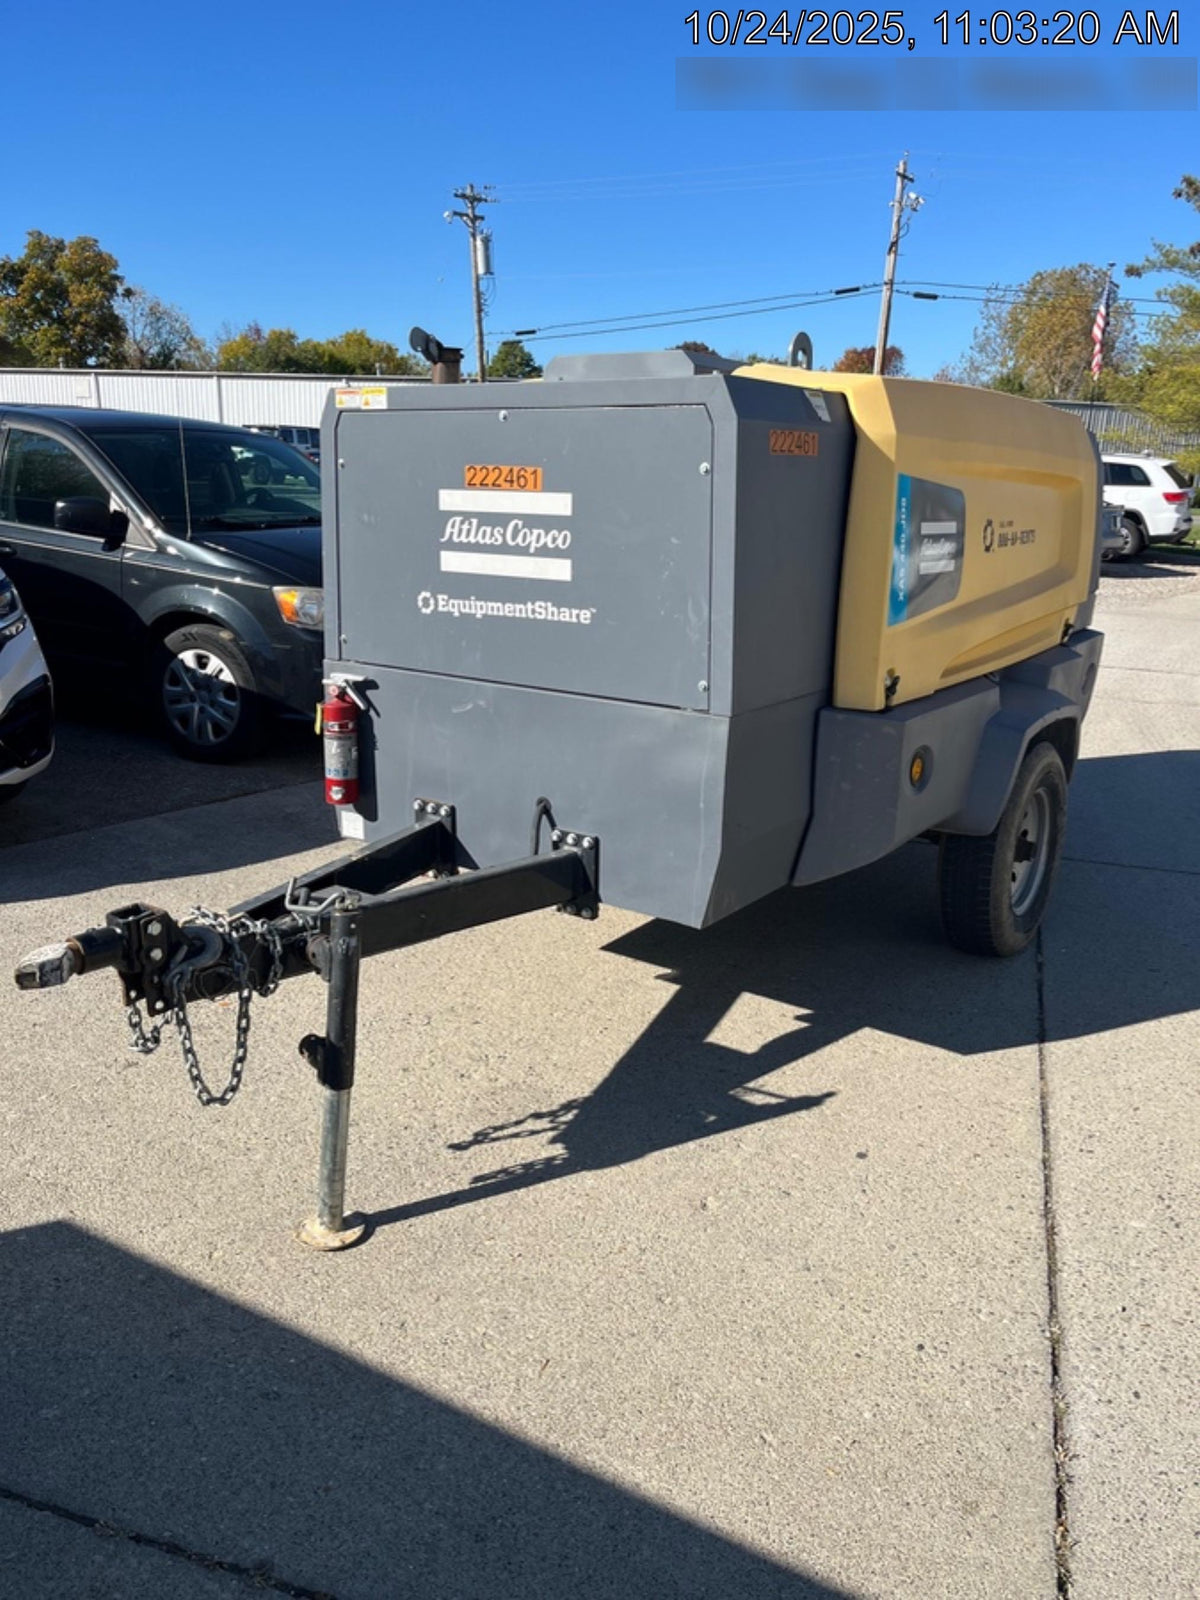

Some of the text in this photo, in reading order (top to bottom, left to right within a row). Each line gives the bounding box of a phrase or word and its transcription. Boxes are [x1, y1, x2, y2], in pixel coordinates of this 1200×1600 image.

[770, 430, 816, 455] 222461
[466, 466, 539, 489] 222461
[440, 516, 572, 553] Atlas Copco
[437, 594, 592, 624] EquipmentShare
